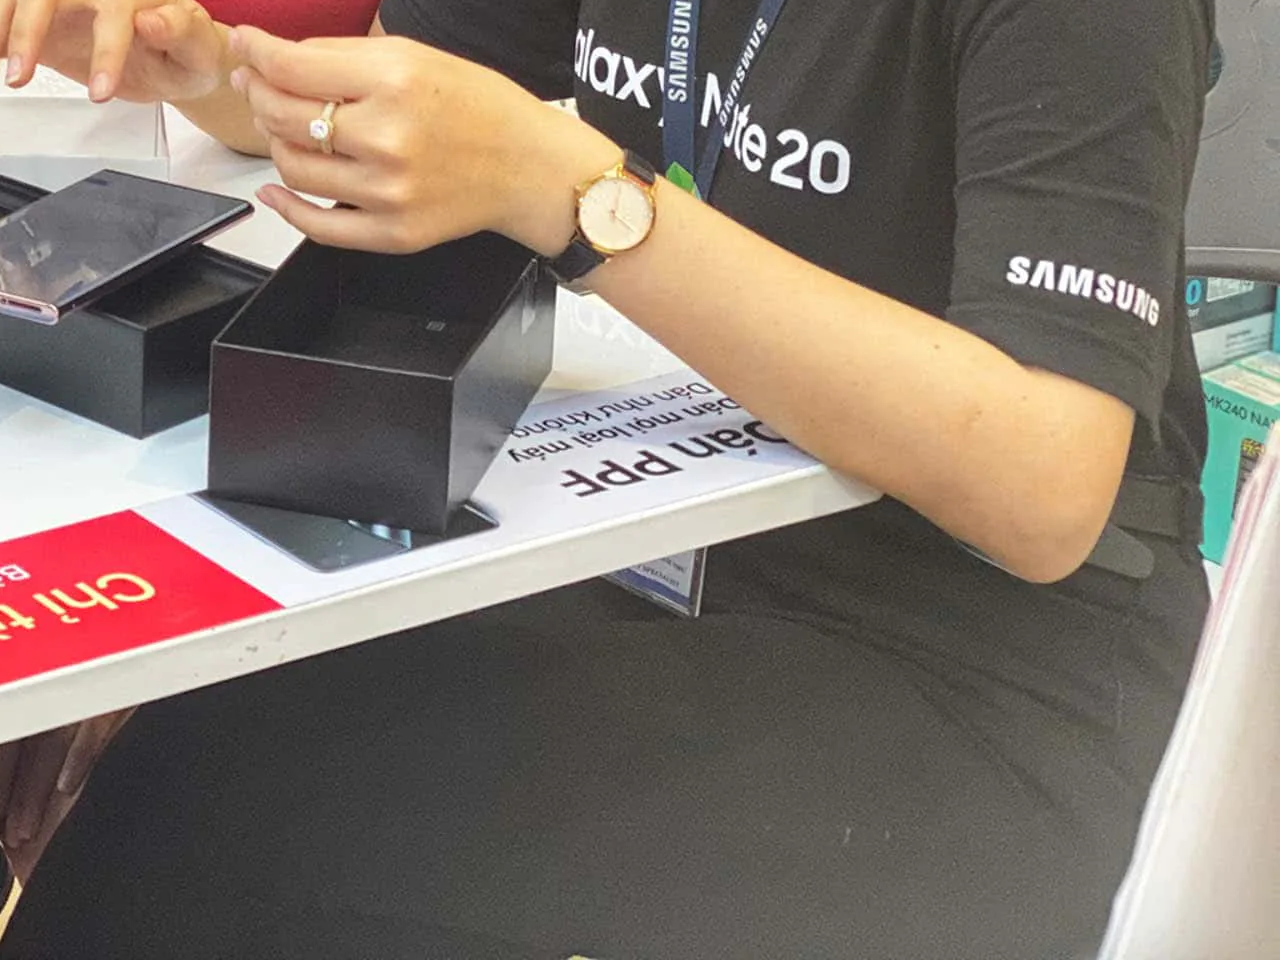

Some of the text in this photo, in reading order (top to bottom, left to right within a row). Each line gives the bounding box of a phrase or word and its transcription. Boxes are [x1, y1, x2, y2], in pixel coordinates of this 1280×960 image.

[719, 17, 769, 127] SAMSUNG
[770, 128, 851, 195] 20
[1006, 255, 1160, 327] SAMSUNG
[596, 392, 654, 420] như
[655, 381, 715, 400] Dán
[571, 425, 633, 449] loại
[625, 411, 685, 435] mọi
[507, 439, 576, 464] máy
[560, 450, 683, 497] PPF
[32, 572, 156, 624] Chỉ
